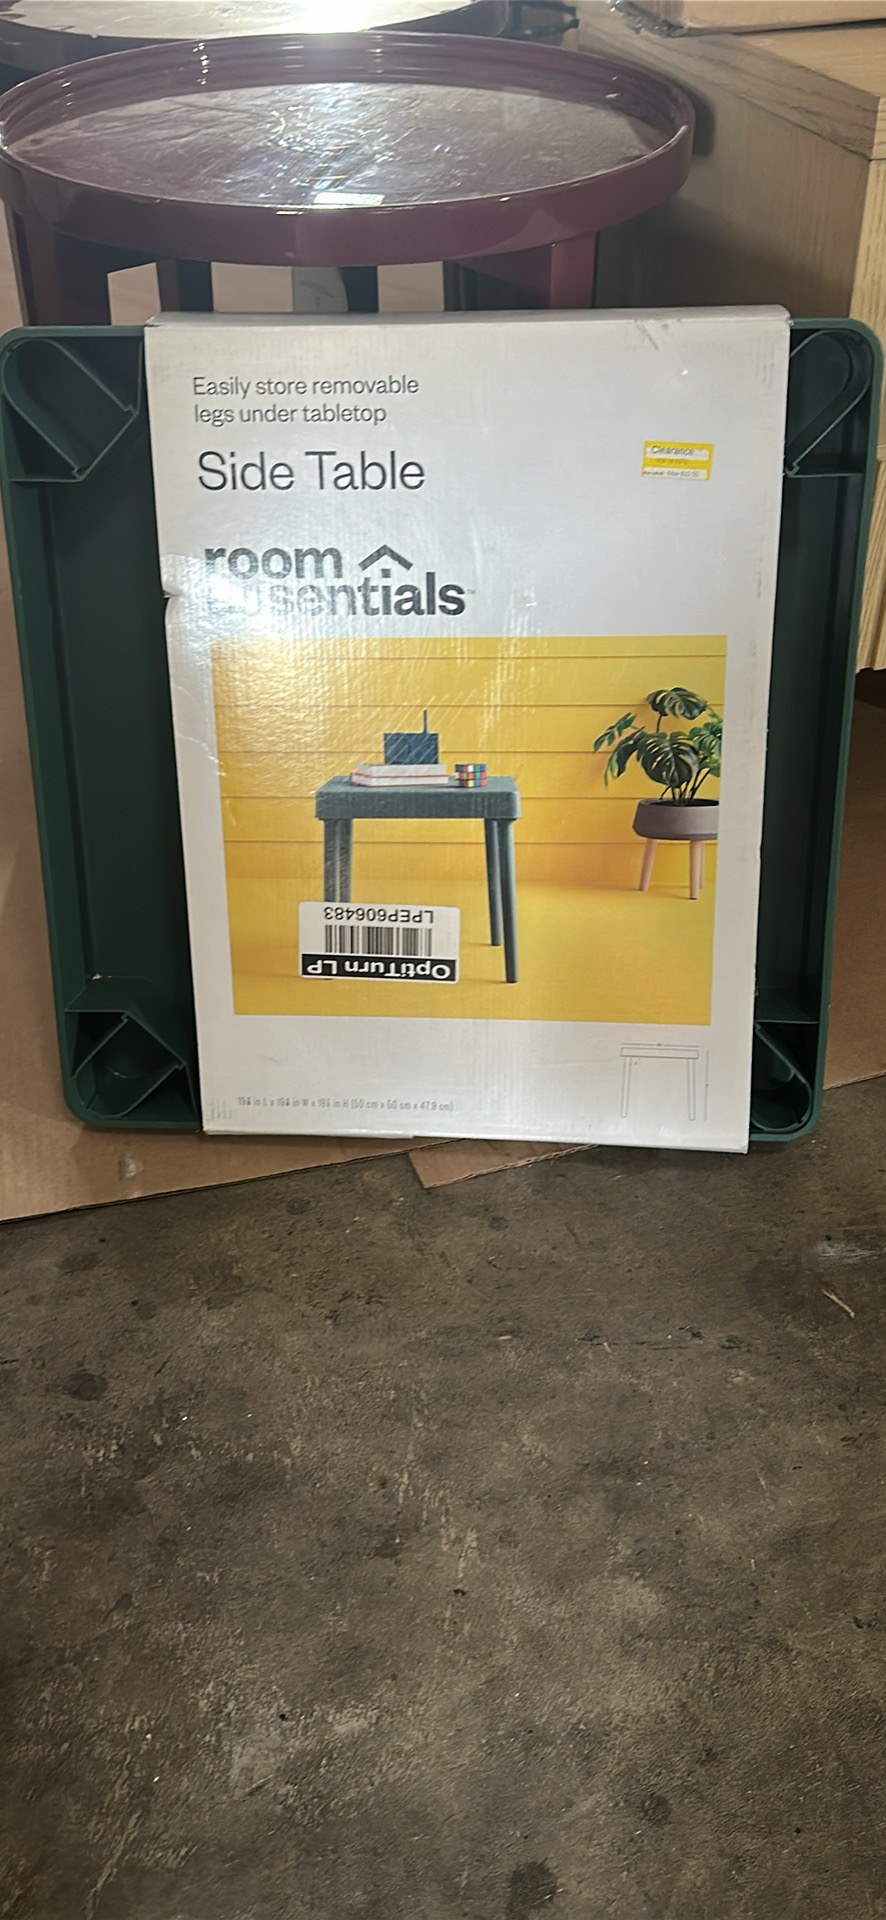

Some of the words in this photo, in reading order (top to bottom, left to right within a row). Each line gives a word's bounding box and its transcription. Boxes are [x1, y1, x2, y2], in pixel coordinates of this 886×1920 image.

[193, 377, 251, 399] Easily
[255, 379, 307, 394] store
[312, 375, 419, 394] removable
[194, 404, 234, 427] legs
[240, 404, 298, 422] under
[302, 404, 387, 425] tabletop
[198, 451, 295, 490] Side
[304, 450, 425, 490] Table
[204, 547, 343, 580] room
[205, 569, 466, 616] esentials
[324, 906, 434, 924] LPEP606483
[306, 959, 338, 975] LP
[344, 961, 451, 980] OptiTurn
